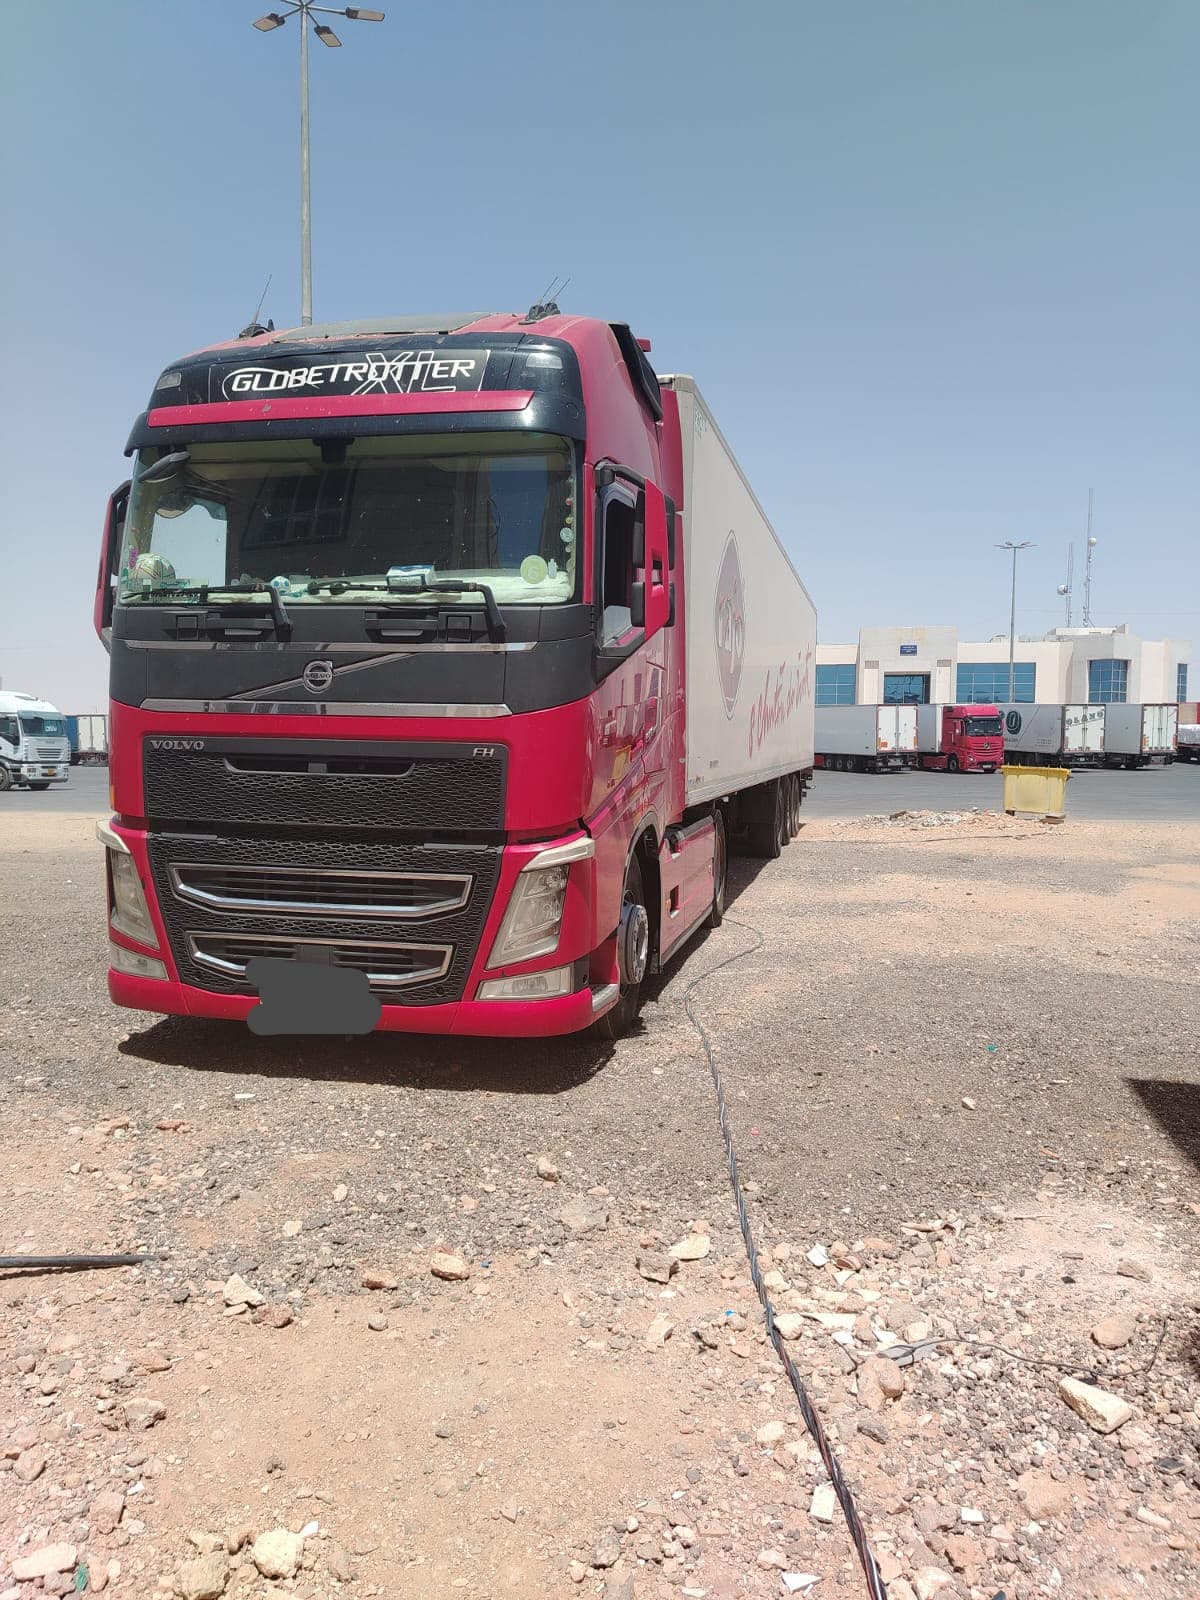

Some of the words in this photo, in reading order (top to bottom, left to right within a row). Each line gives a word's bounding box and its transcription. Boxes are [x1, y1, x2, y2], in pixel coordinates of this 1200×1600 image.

[231, 358, 477, 392] GLOBETROTTER
[150, 739, 205, 751] VOLVO
[472, 746, 496, 759] FH
